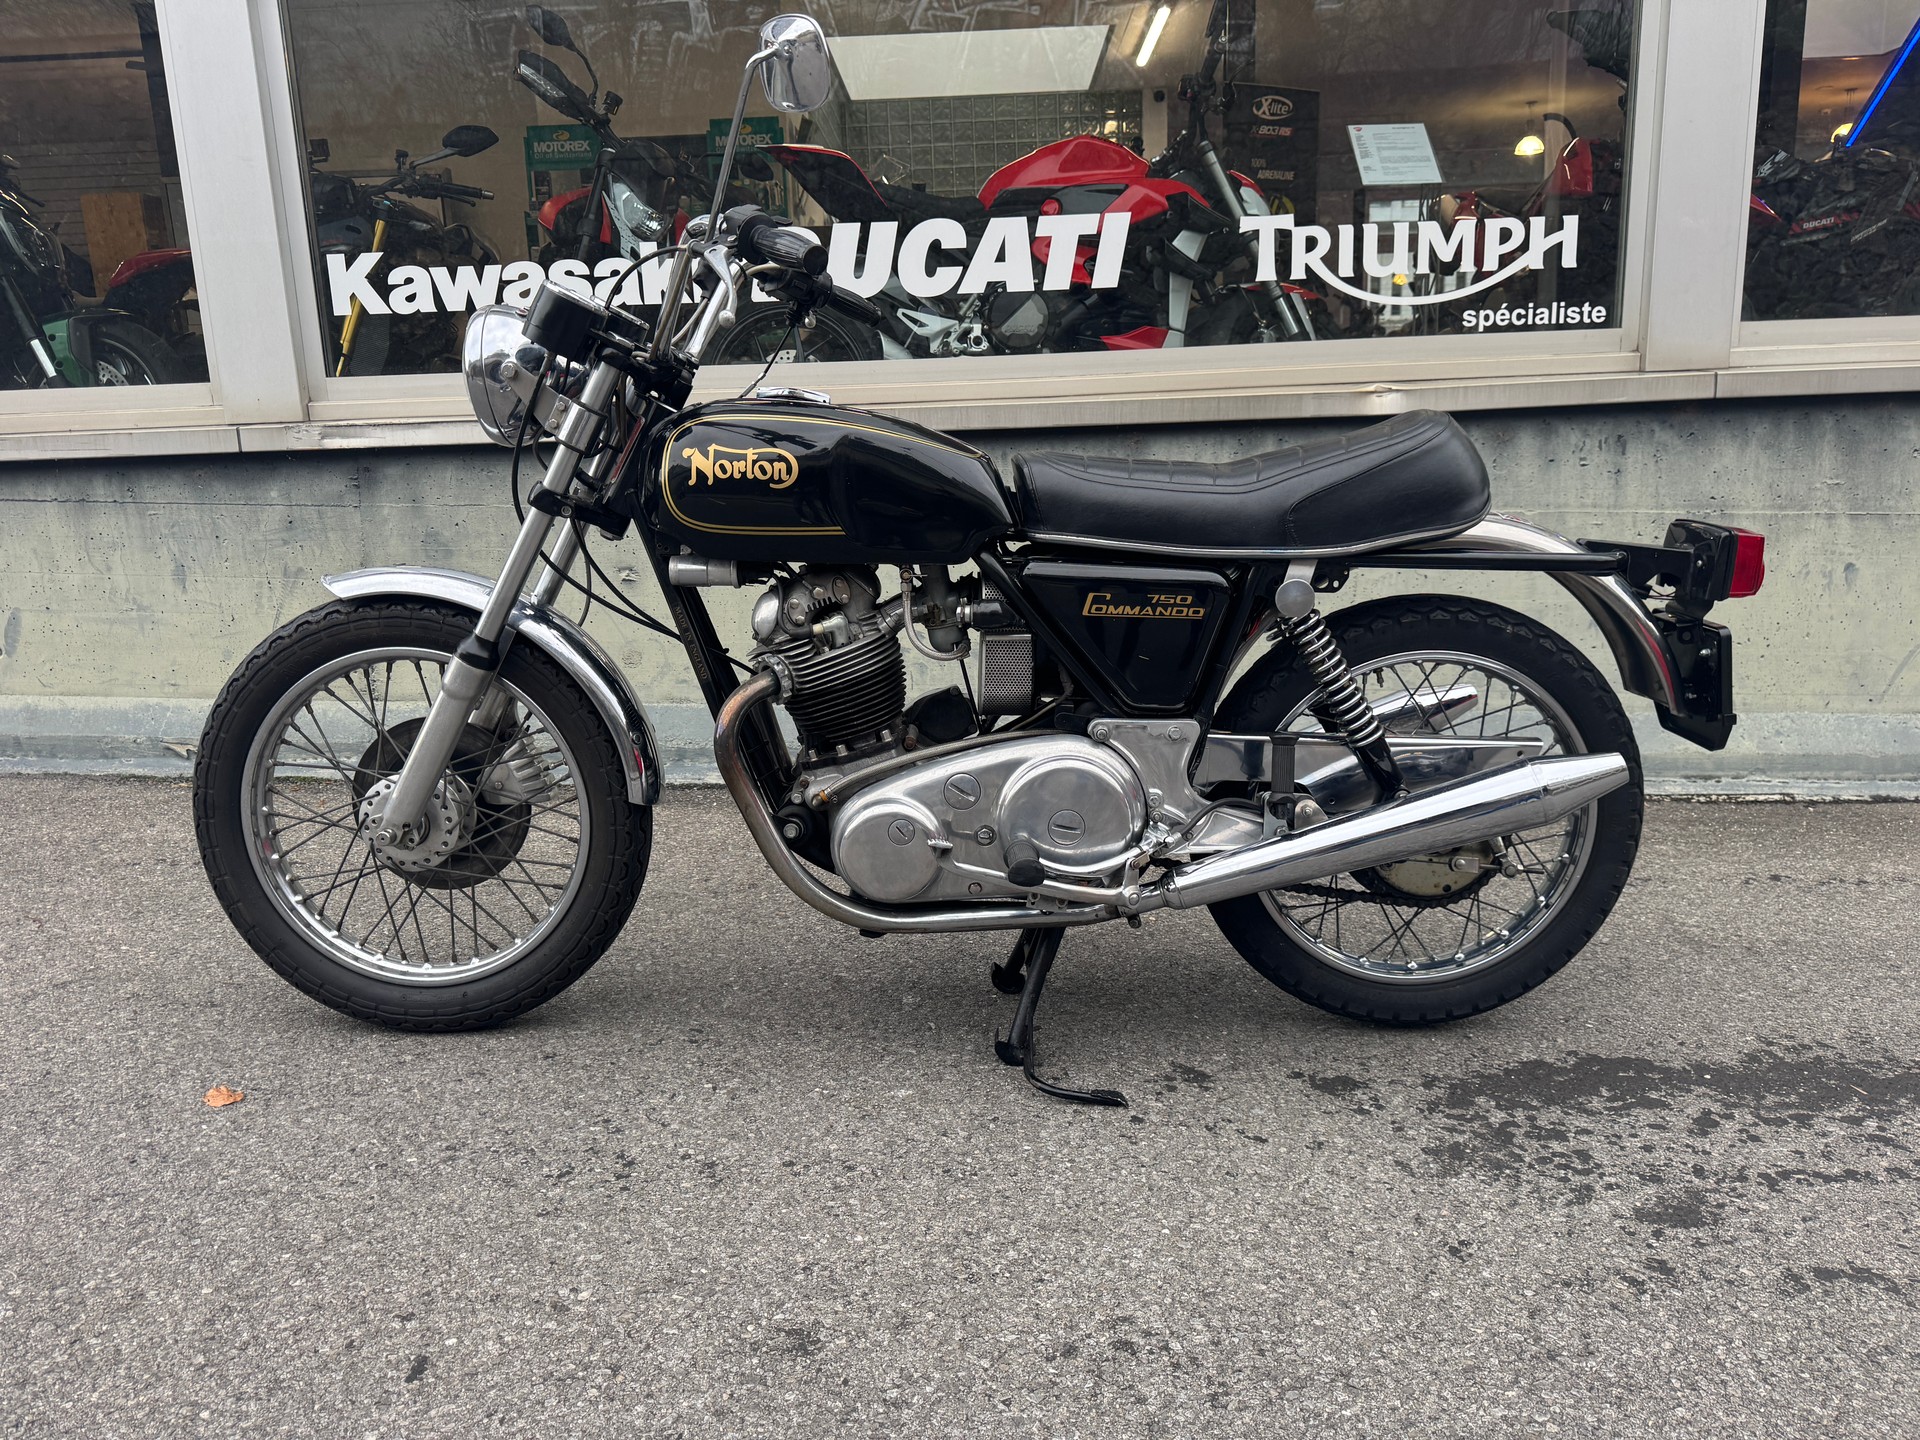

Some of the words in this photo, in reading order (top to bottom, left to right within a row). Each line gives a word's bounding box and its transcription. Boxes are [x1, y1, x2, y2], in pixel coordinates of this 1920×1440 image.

[1258, 97, 1289, 116] X-lite
[533, 140, 590, 153] MOTOREX
[715, 134, 772, 147] MTOREX
[1257, 169, 1295, 180] ADRENALINE
[1803, 216, 1835, 229] DUCATI
[751, 212, 1132, 303] UCATI
[1239, 213, 1579, 305] TRIUMPH
[1462, 301, 1607, 332] spécialiste
[682, 443, 799, 489] Norton
[1082, 592, 1206, 619] COMMANDO
[1147, 594, 1193, 605] 750
[675, 606, 689, 628] MADE
[690, 643, 708, 680] ENGLAND
